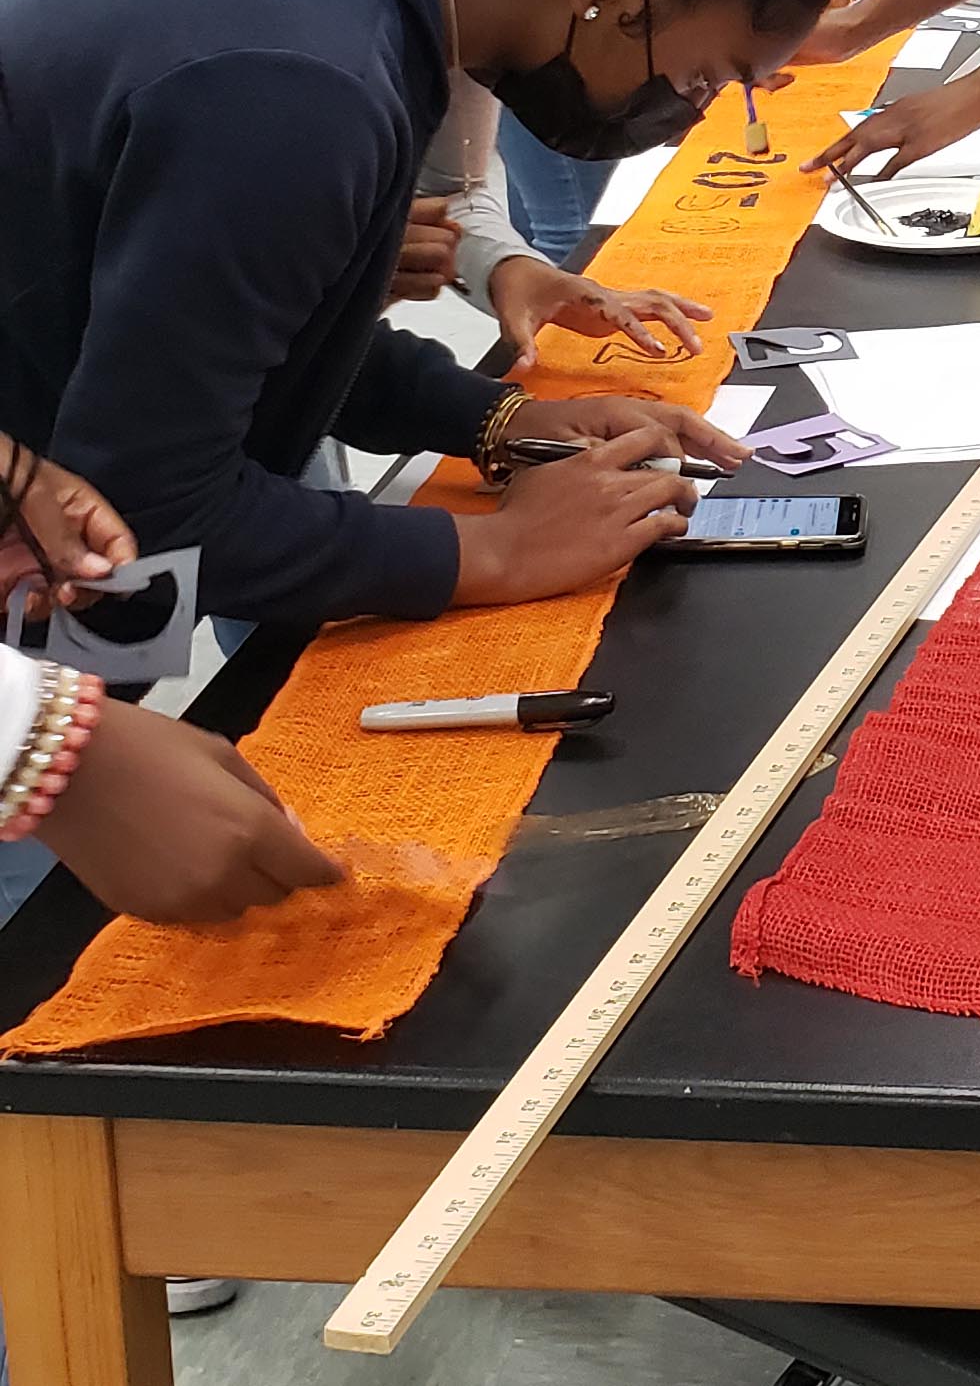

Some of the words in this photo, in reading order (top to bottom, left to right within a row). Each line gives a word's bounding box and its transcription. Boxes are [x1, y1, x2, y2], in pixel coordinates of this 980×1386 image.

[648, 927, 667, 937] 27
[609, 980, 628, 992] 29
[587, 1008, 607, 1021] 30
[565, 1037, 586, 1049] 31
[444, 1199, 467, 1213] 36
[360, 1310, 383, 1327] 39
